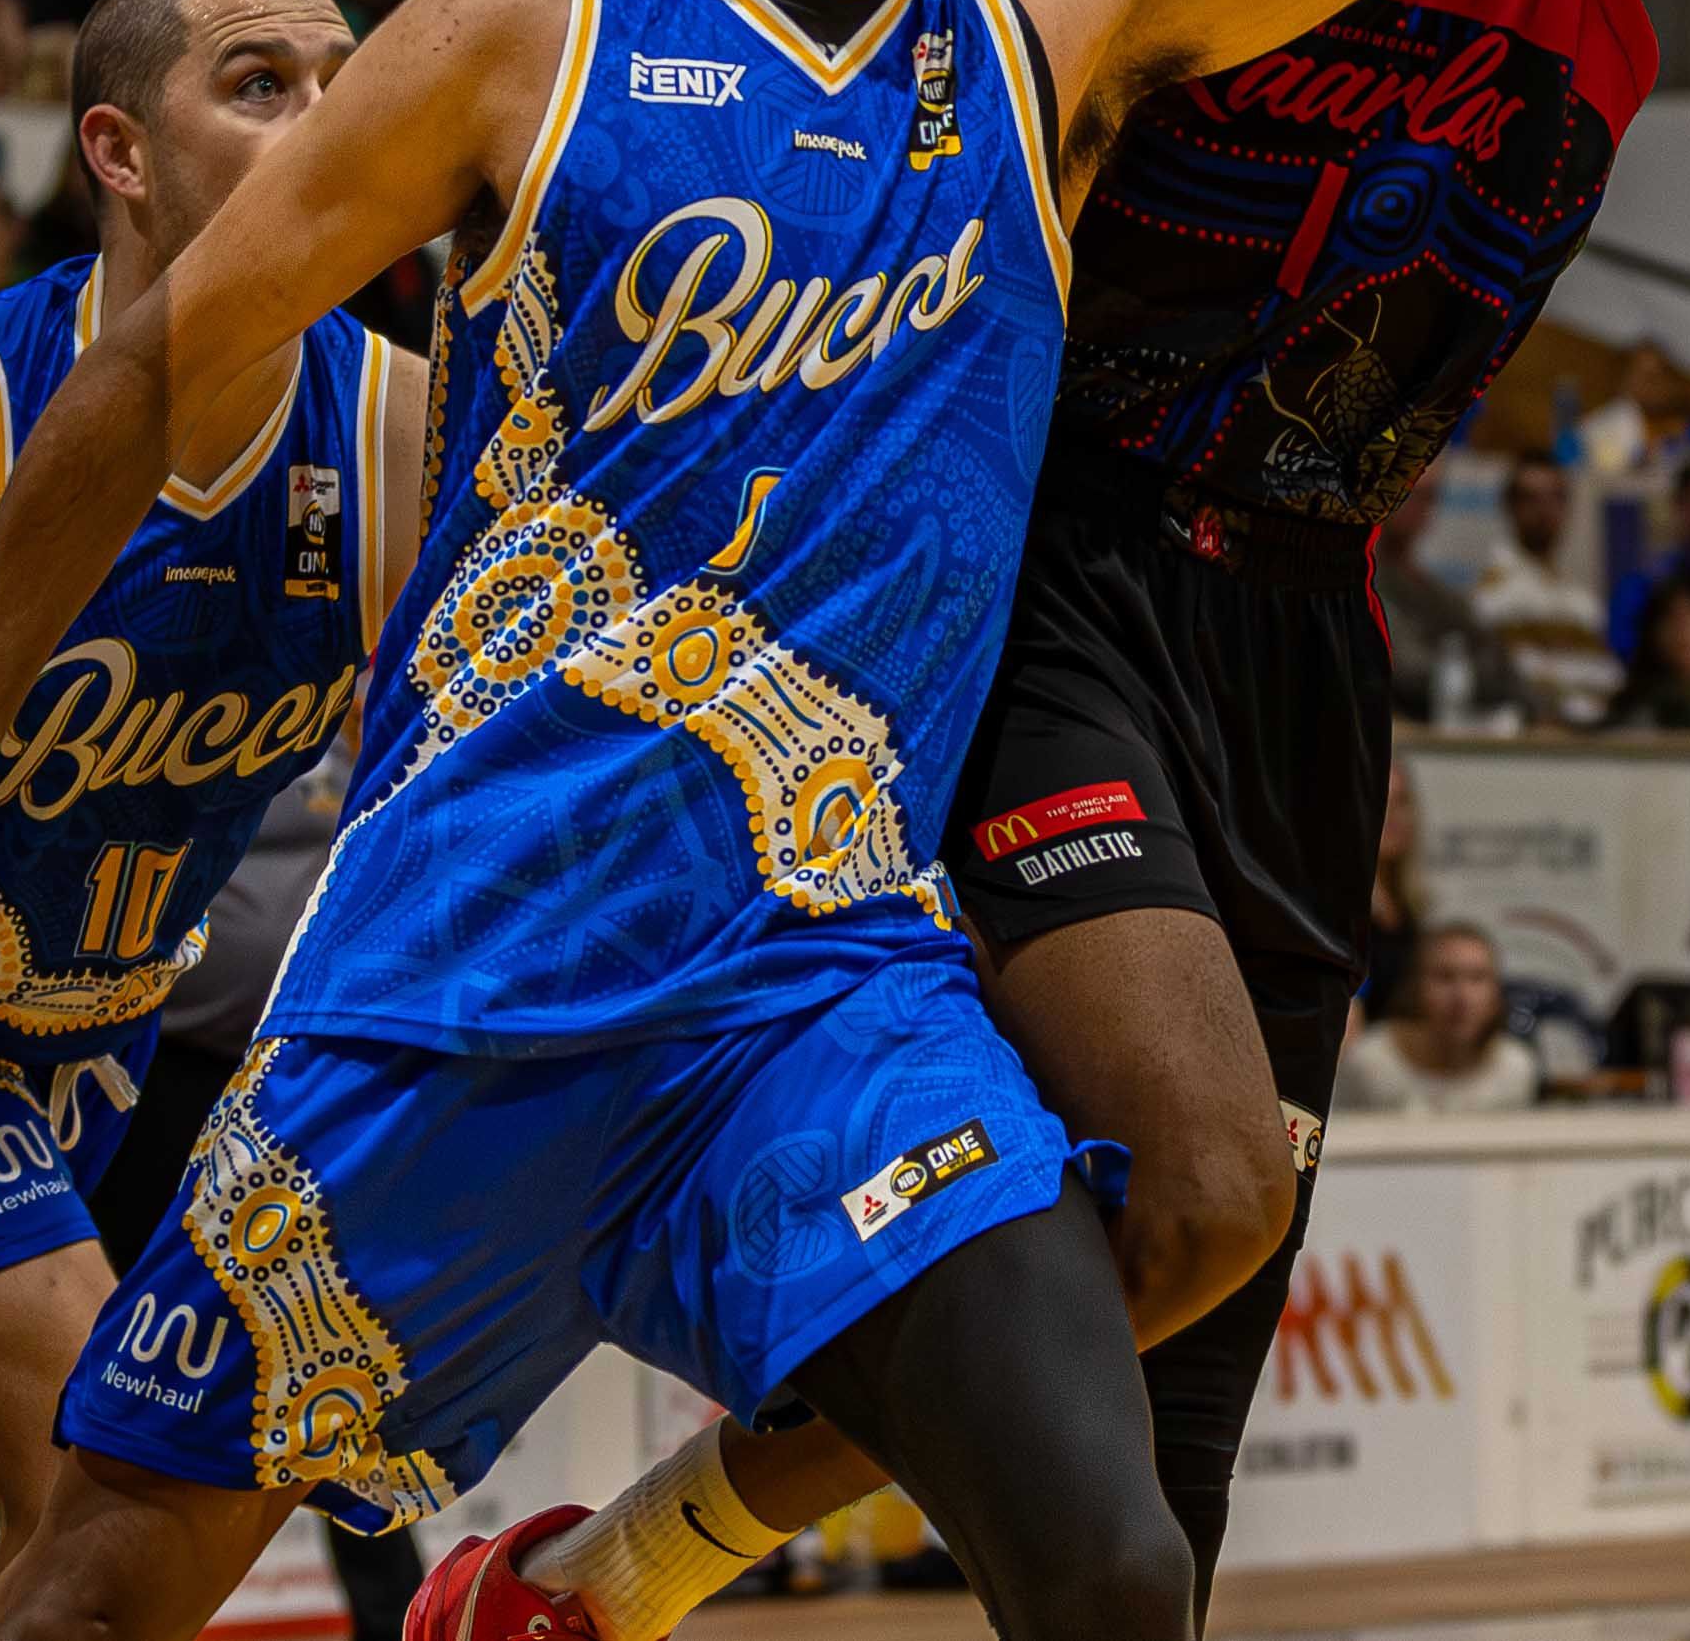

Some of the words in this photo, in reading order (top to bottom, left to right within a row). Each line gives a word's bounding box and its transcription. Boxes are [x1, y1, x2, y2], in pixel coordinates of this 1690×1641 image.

[629, 51, 747, 108] FENIX
[793, 128, 867, 160] imagepak
[1069, 804, 1113, 821] FAMILY
[1042, 830, 1143, 878] ATHLETIC
[77, 841, 193, 964] 10
[926, 1128, 981, 1170] ONE
[100, 1360, 204, 1414] Newhaul
